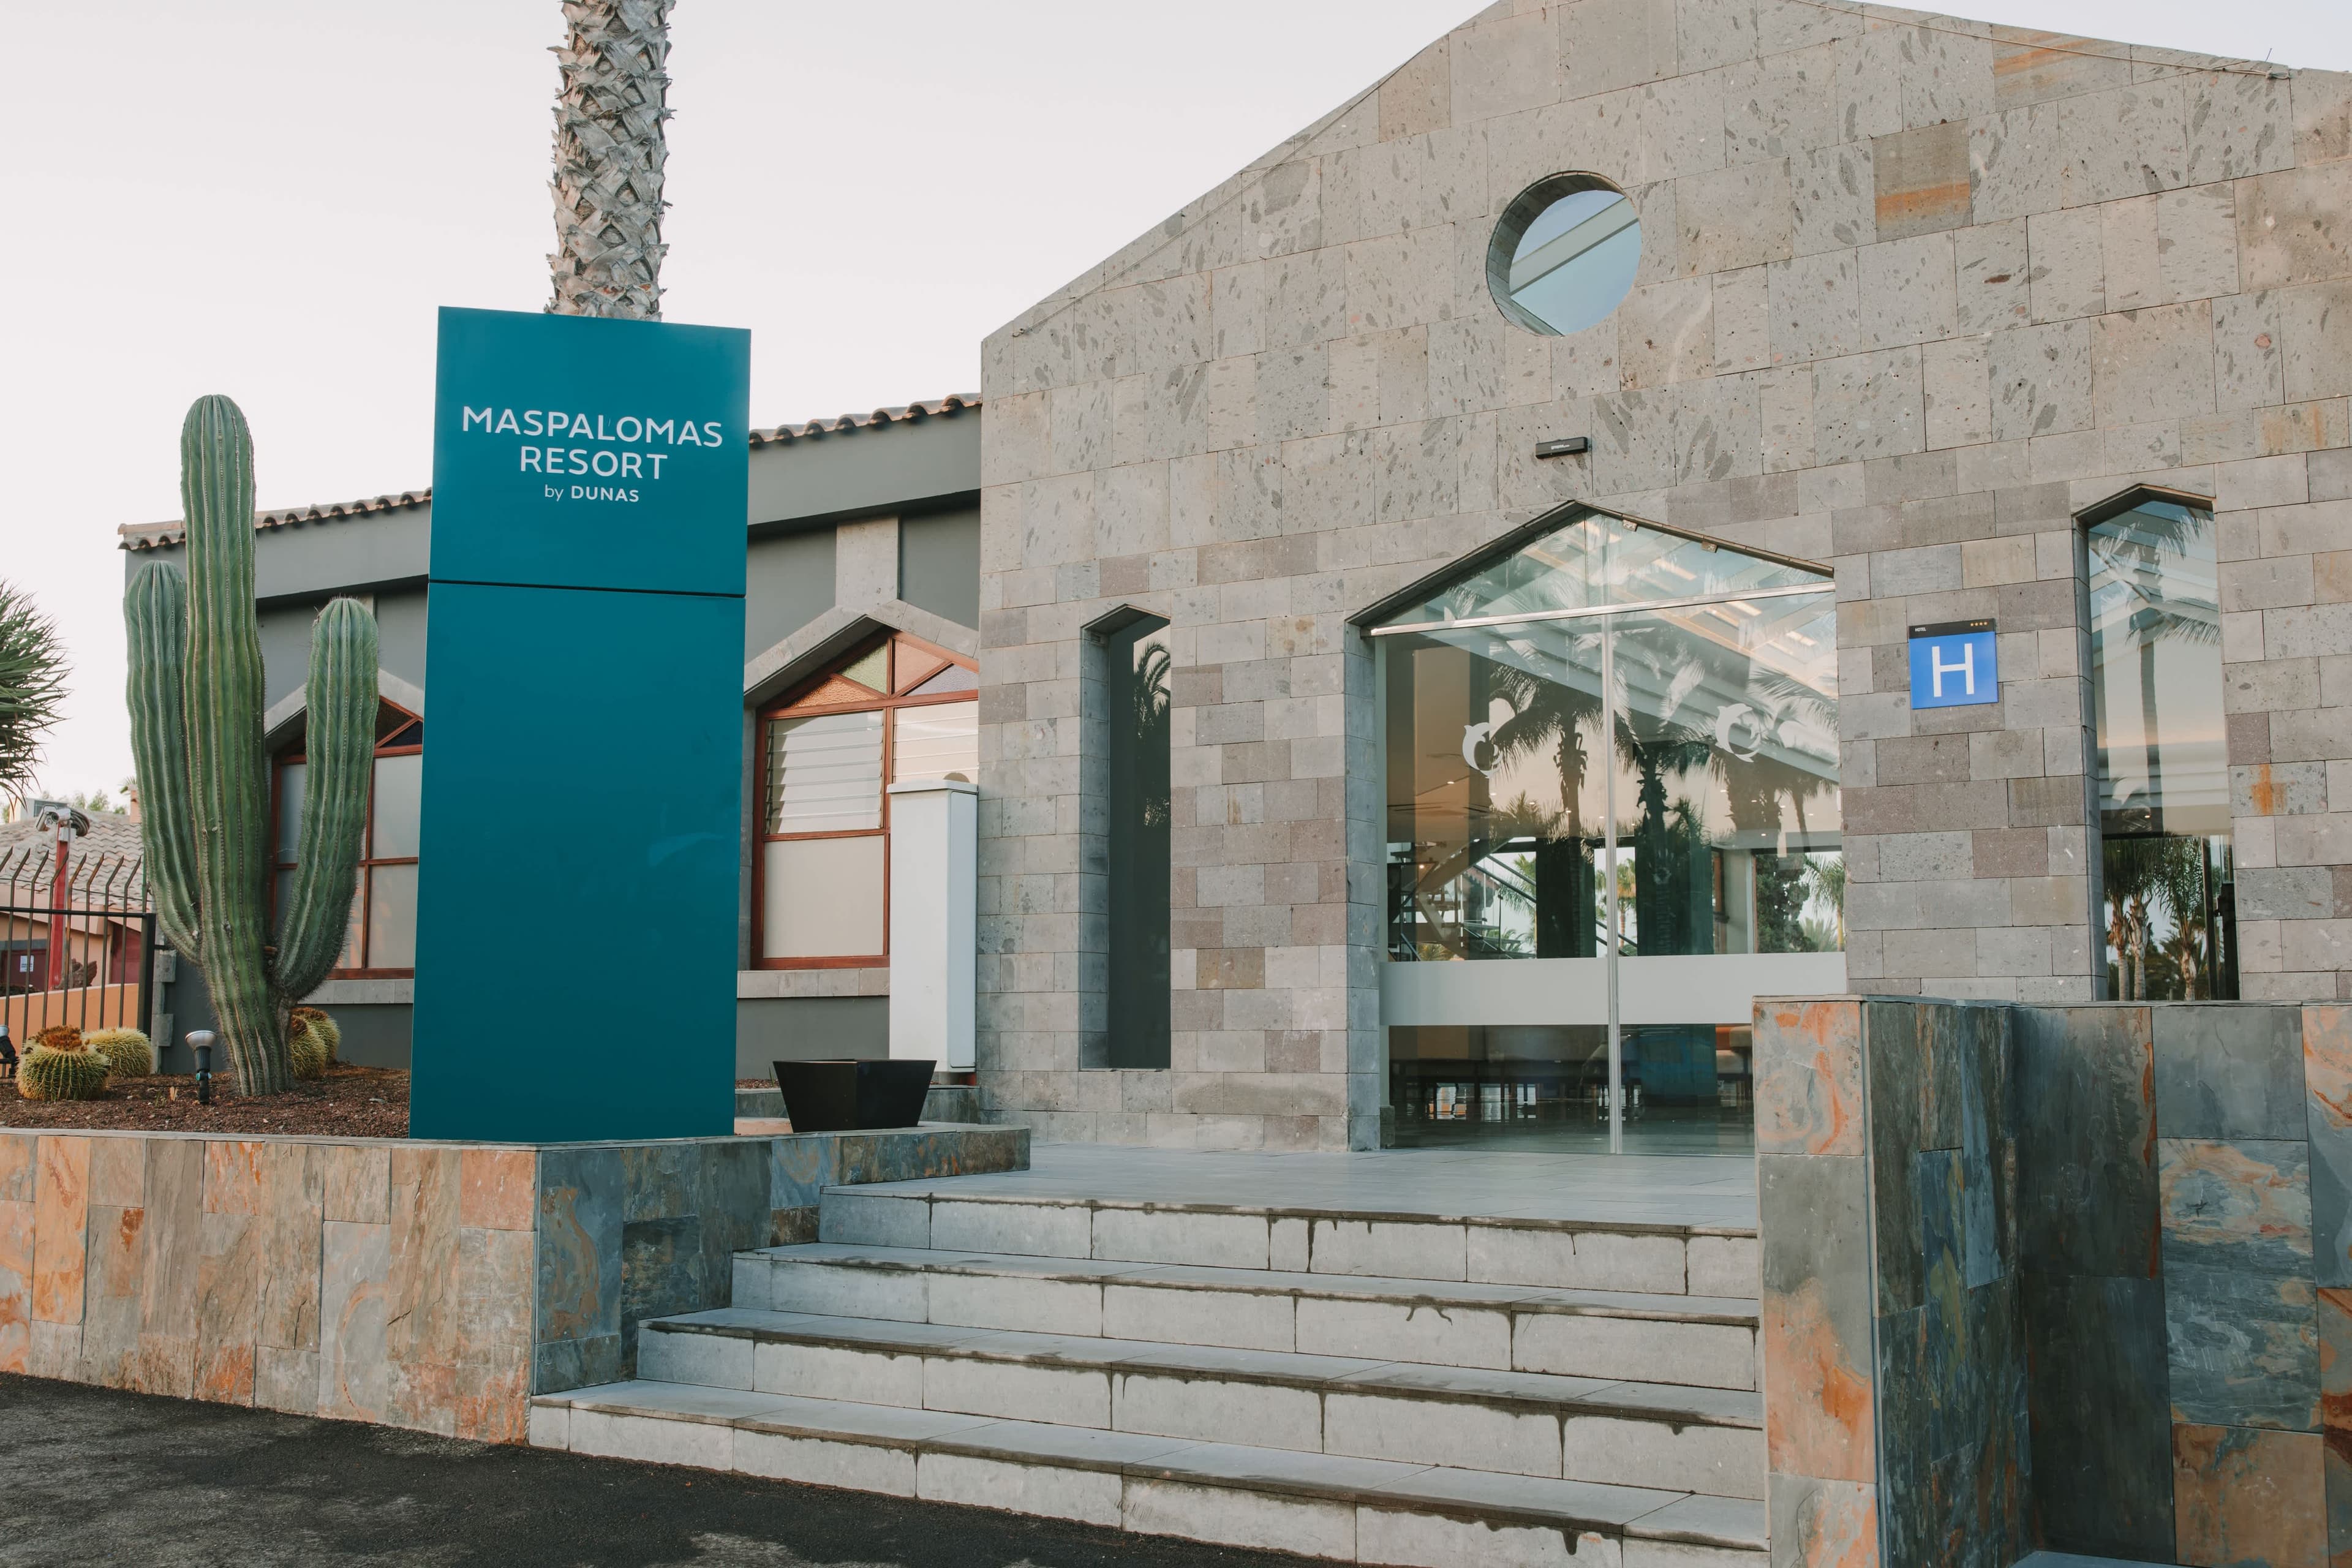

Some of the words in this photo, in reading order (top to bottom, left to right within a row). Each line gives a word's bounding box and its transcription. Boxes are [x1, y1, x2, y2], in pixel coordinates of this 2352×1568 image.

[462, 405, 723, 447] MASPALOMAS
[521, 446, 668, 480] RESORT
[544, 484, 564, 502] by
[571, 485, 639, 502] DUNAS
[1931, 643, 1975, 698] H
